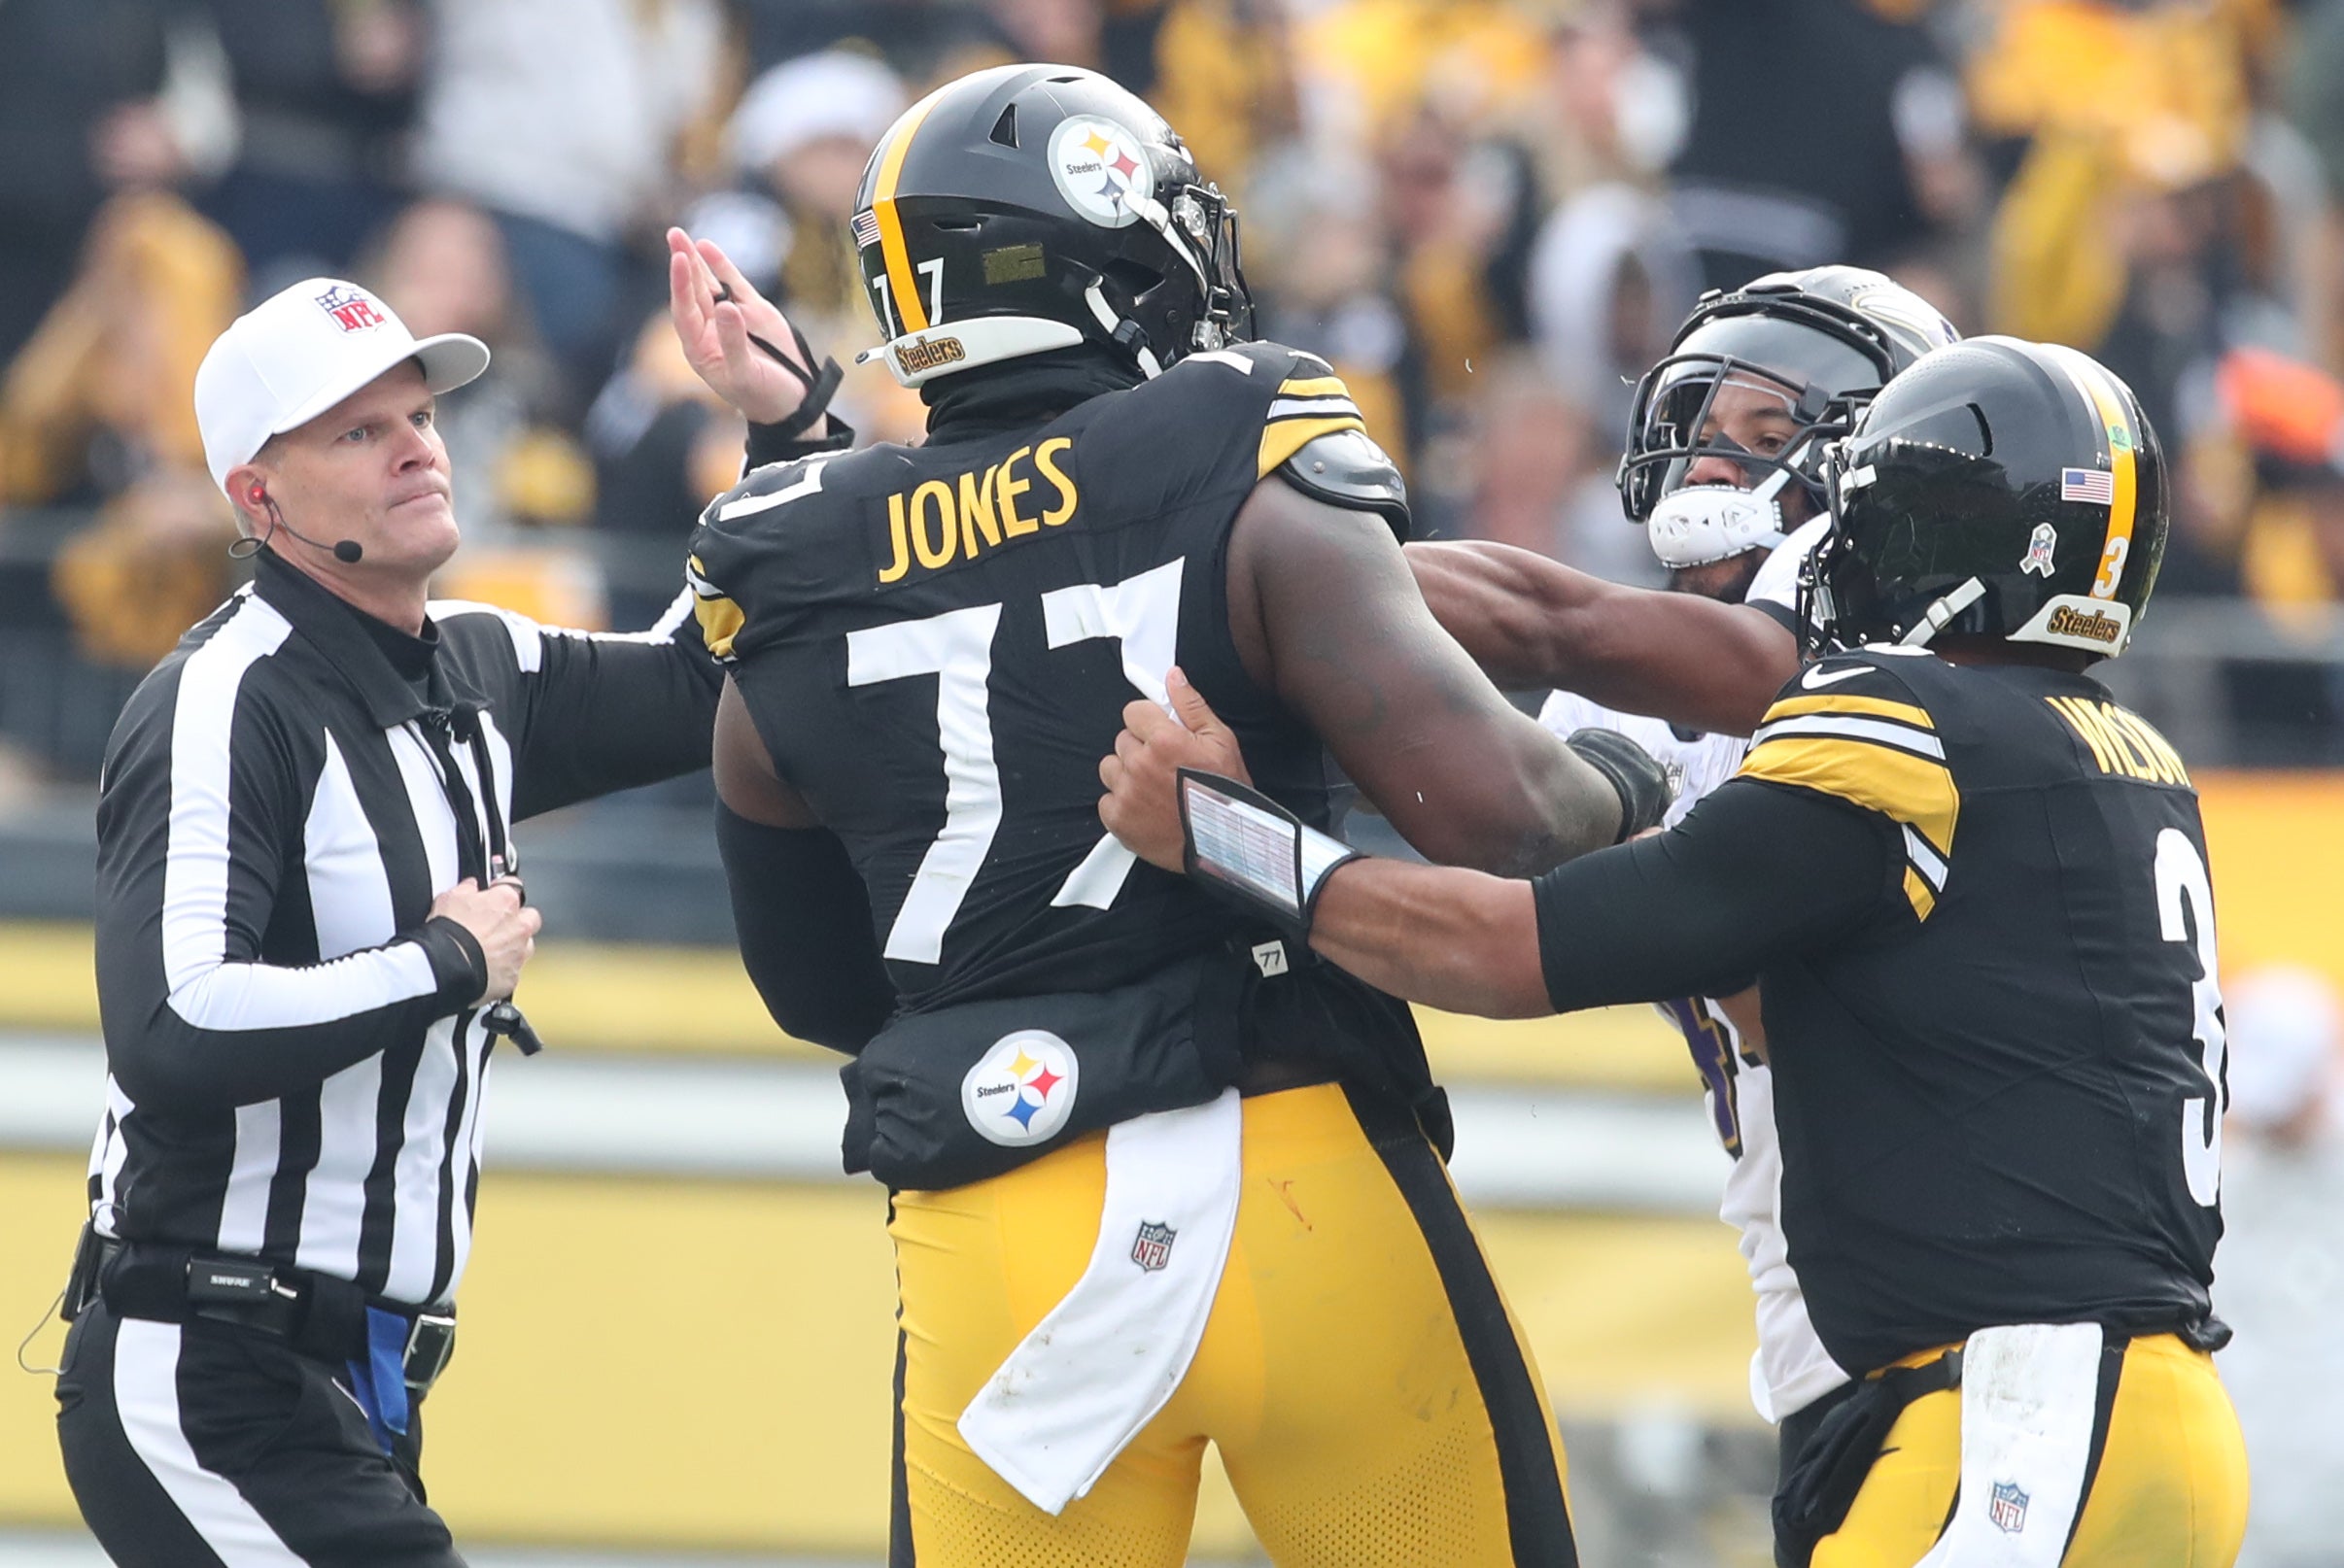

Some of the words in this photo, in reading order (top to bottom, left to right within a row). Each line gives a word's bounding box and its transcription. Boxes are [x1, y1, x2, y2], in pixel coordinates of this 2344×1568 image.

[210, 303, 251, 317] SHURE
[331, 300, 385, 330] NFL
[894, 336, 965, 376] Steelers
[879, 437, 1080, 583] JONES
[2093, 536, 2129, 597] 3
[2047, 605, 2121, 643] Steelers
[845, 555, 1185, 965] 77
[1259, 949, 1281, 968] 77
[2154, 827, 2226, 1208] 3
[977, 1083, 1016, 1098] Steelers
[1135, 1239, 1166, 1267] NFL
[1993, 1499, 2020, 1528] NFL
